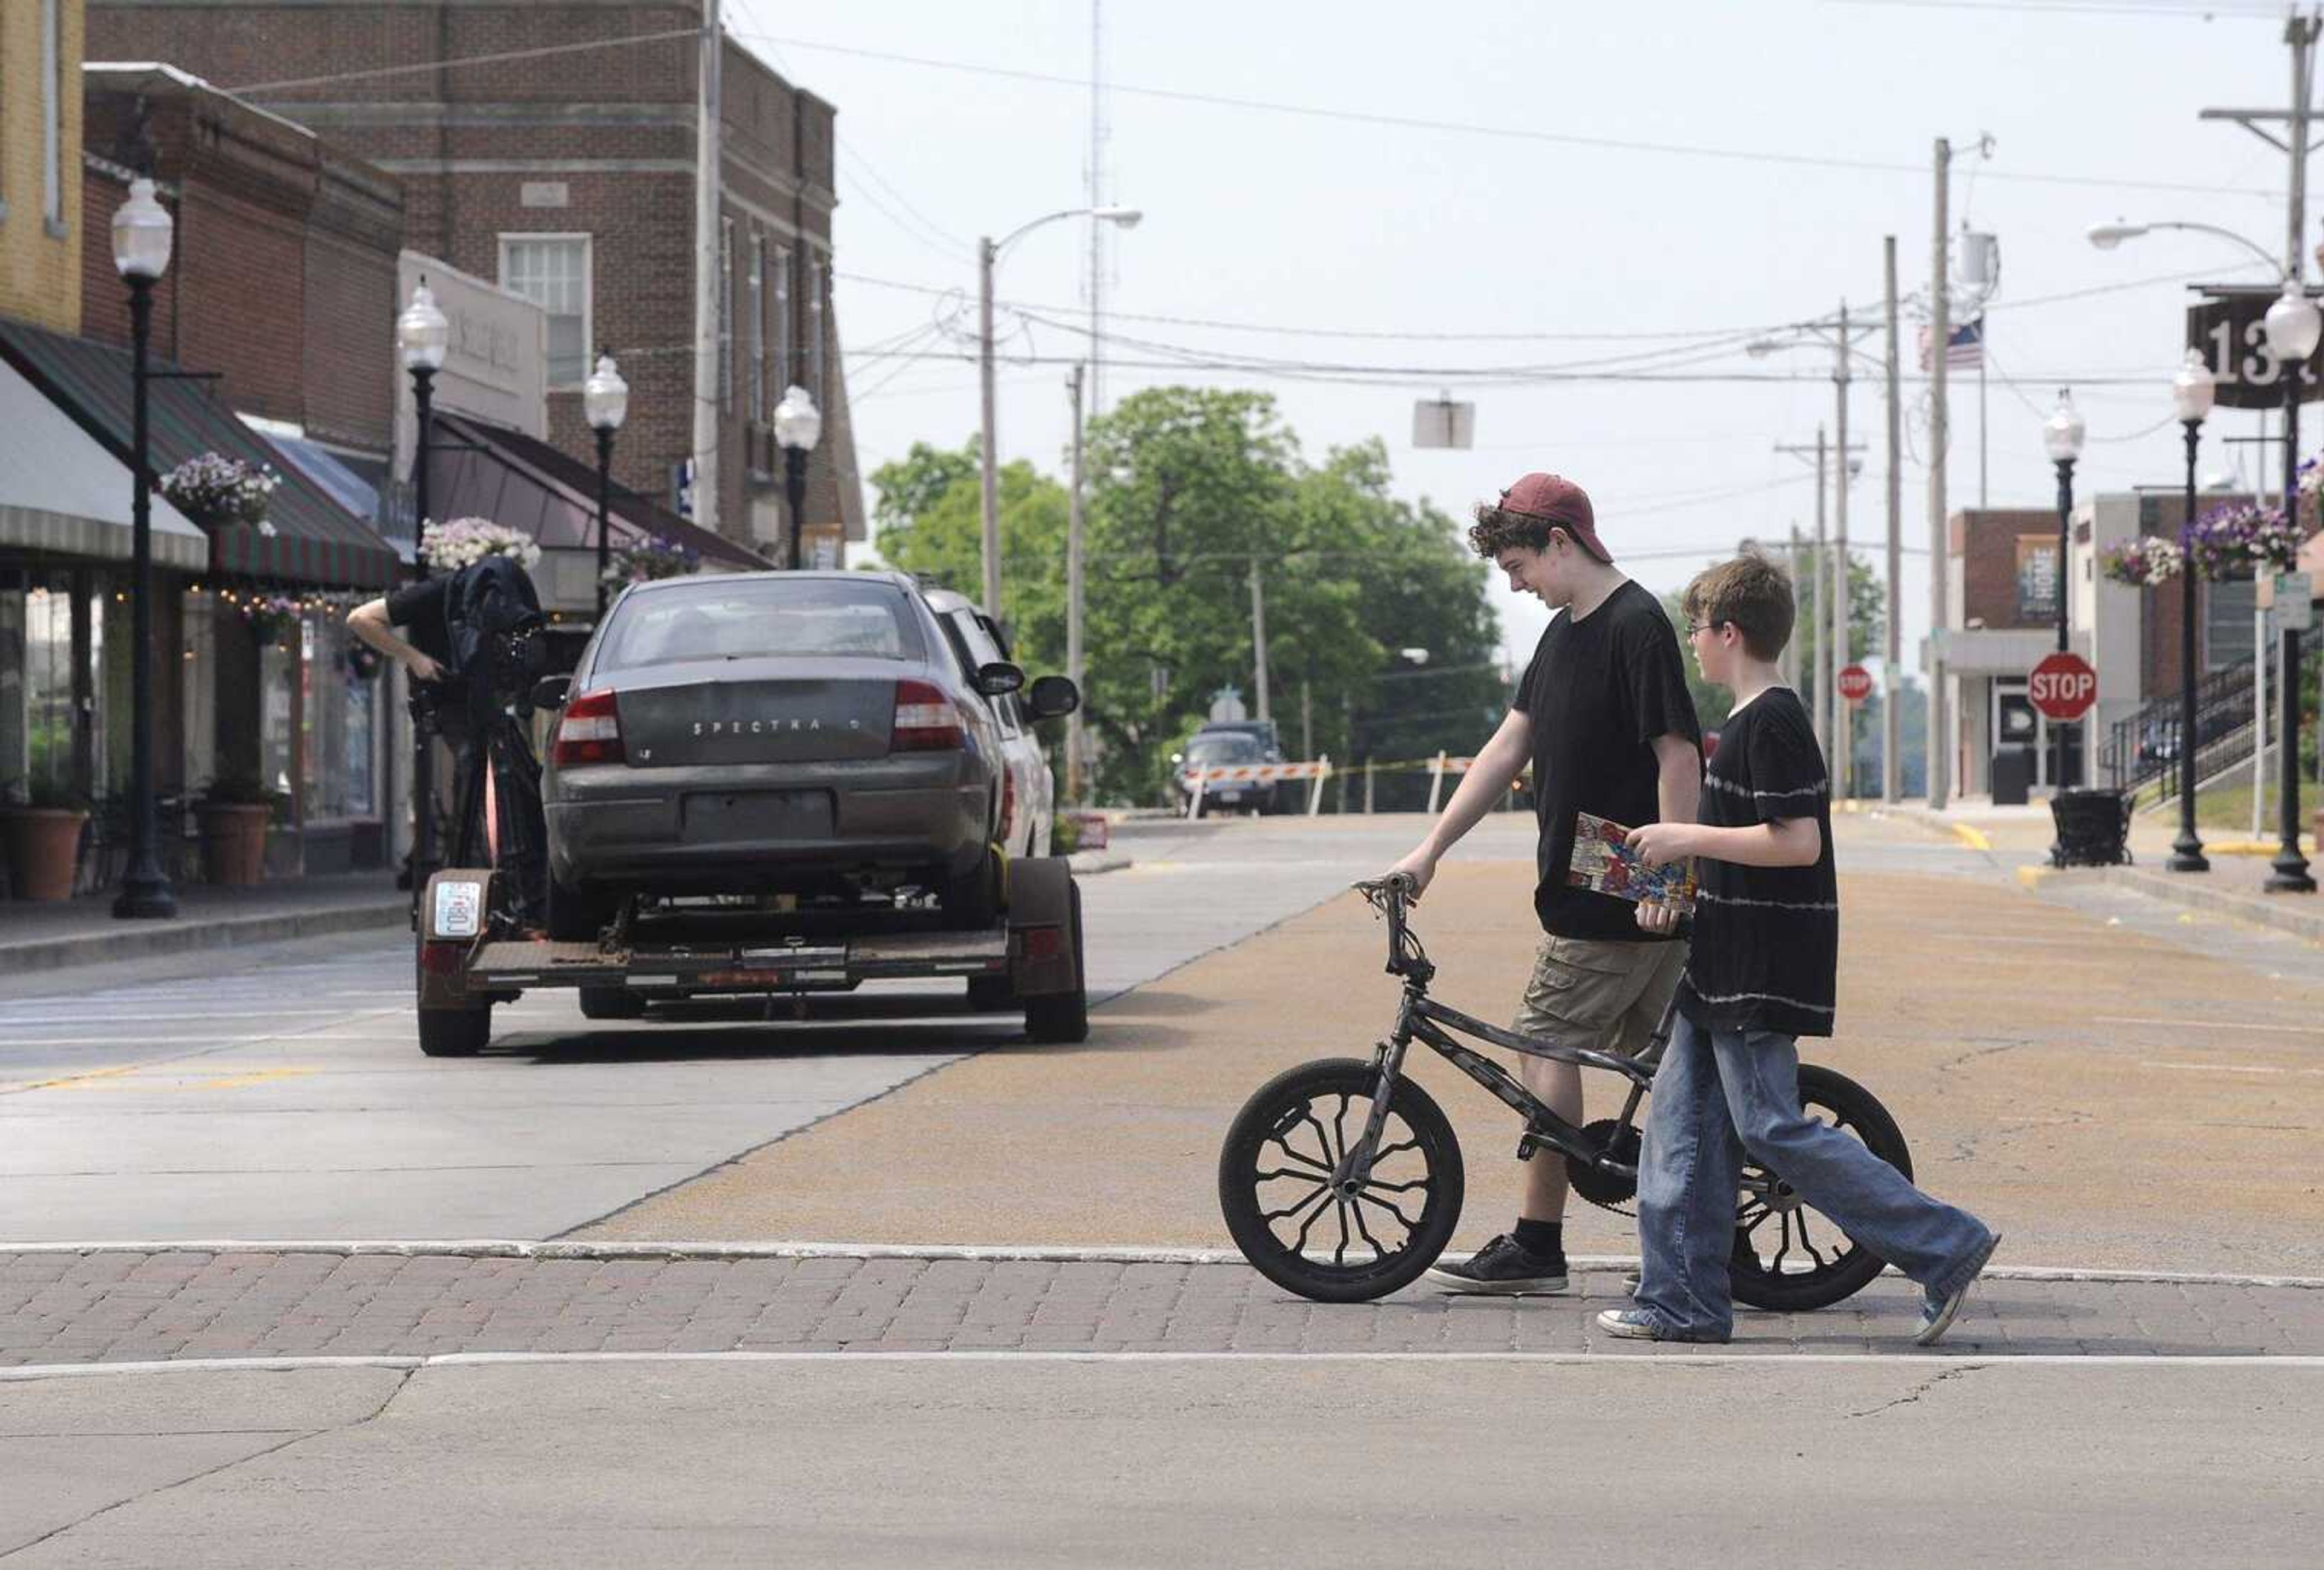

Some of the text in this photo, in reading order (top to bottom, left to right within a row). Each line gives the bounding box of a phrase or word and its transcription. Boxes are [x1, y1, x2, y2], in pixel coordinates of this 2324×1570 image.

[1839, 674, 1871, 690] STOP
[2033, 672, 2093, 700] STOP
[694, 718, 820, 735] SPECTRA
